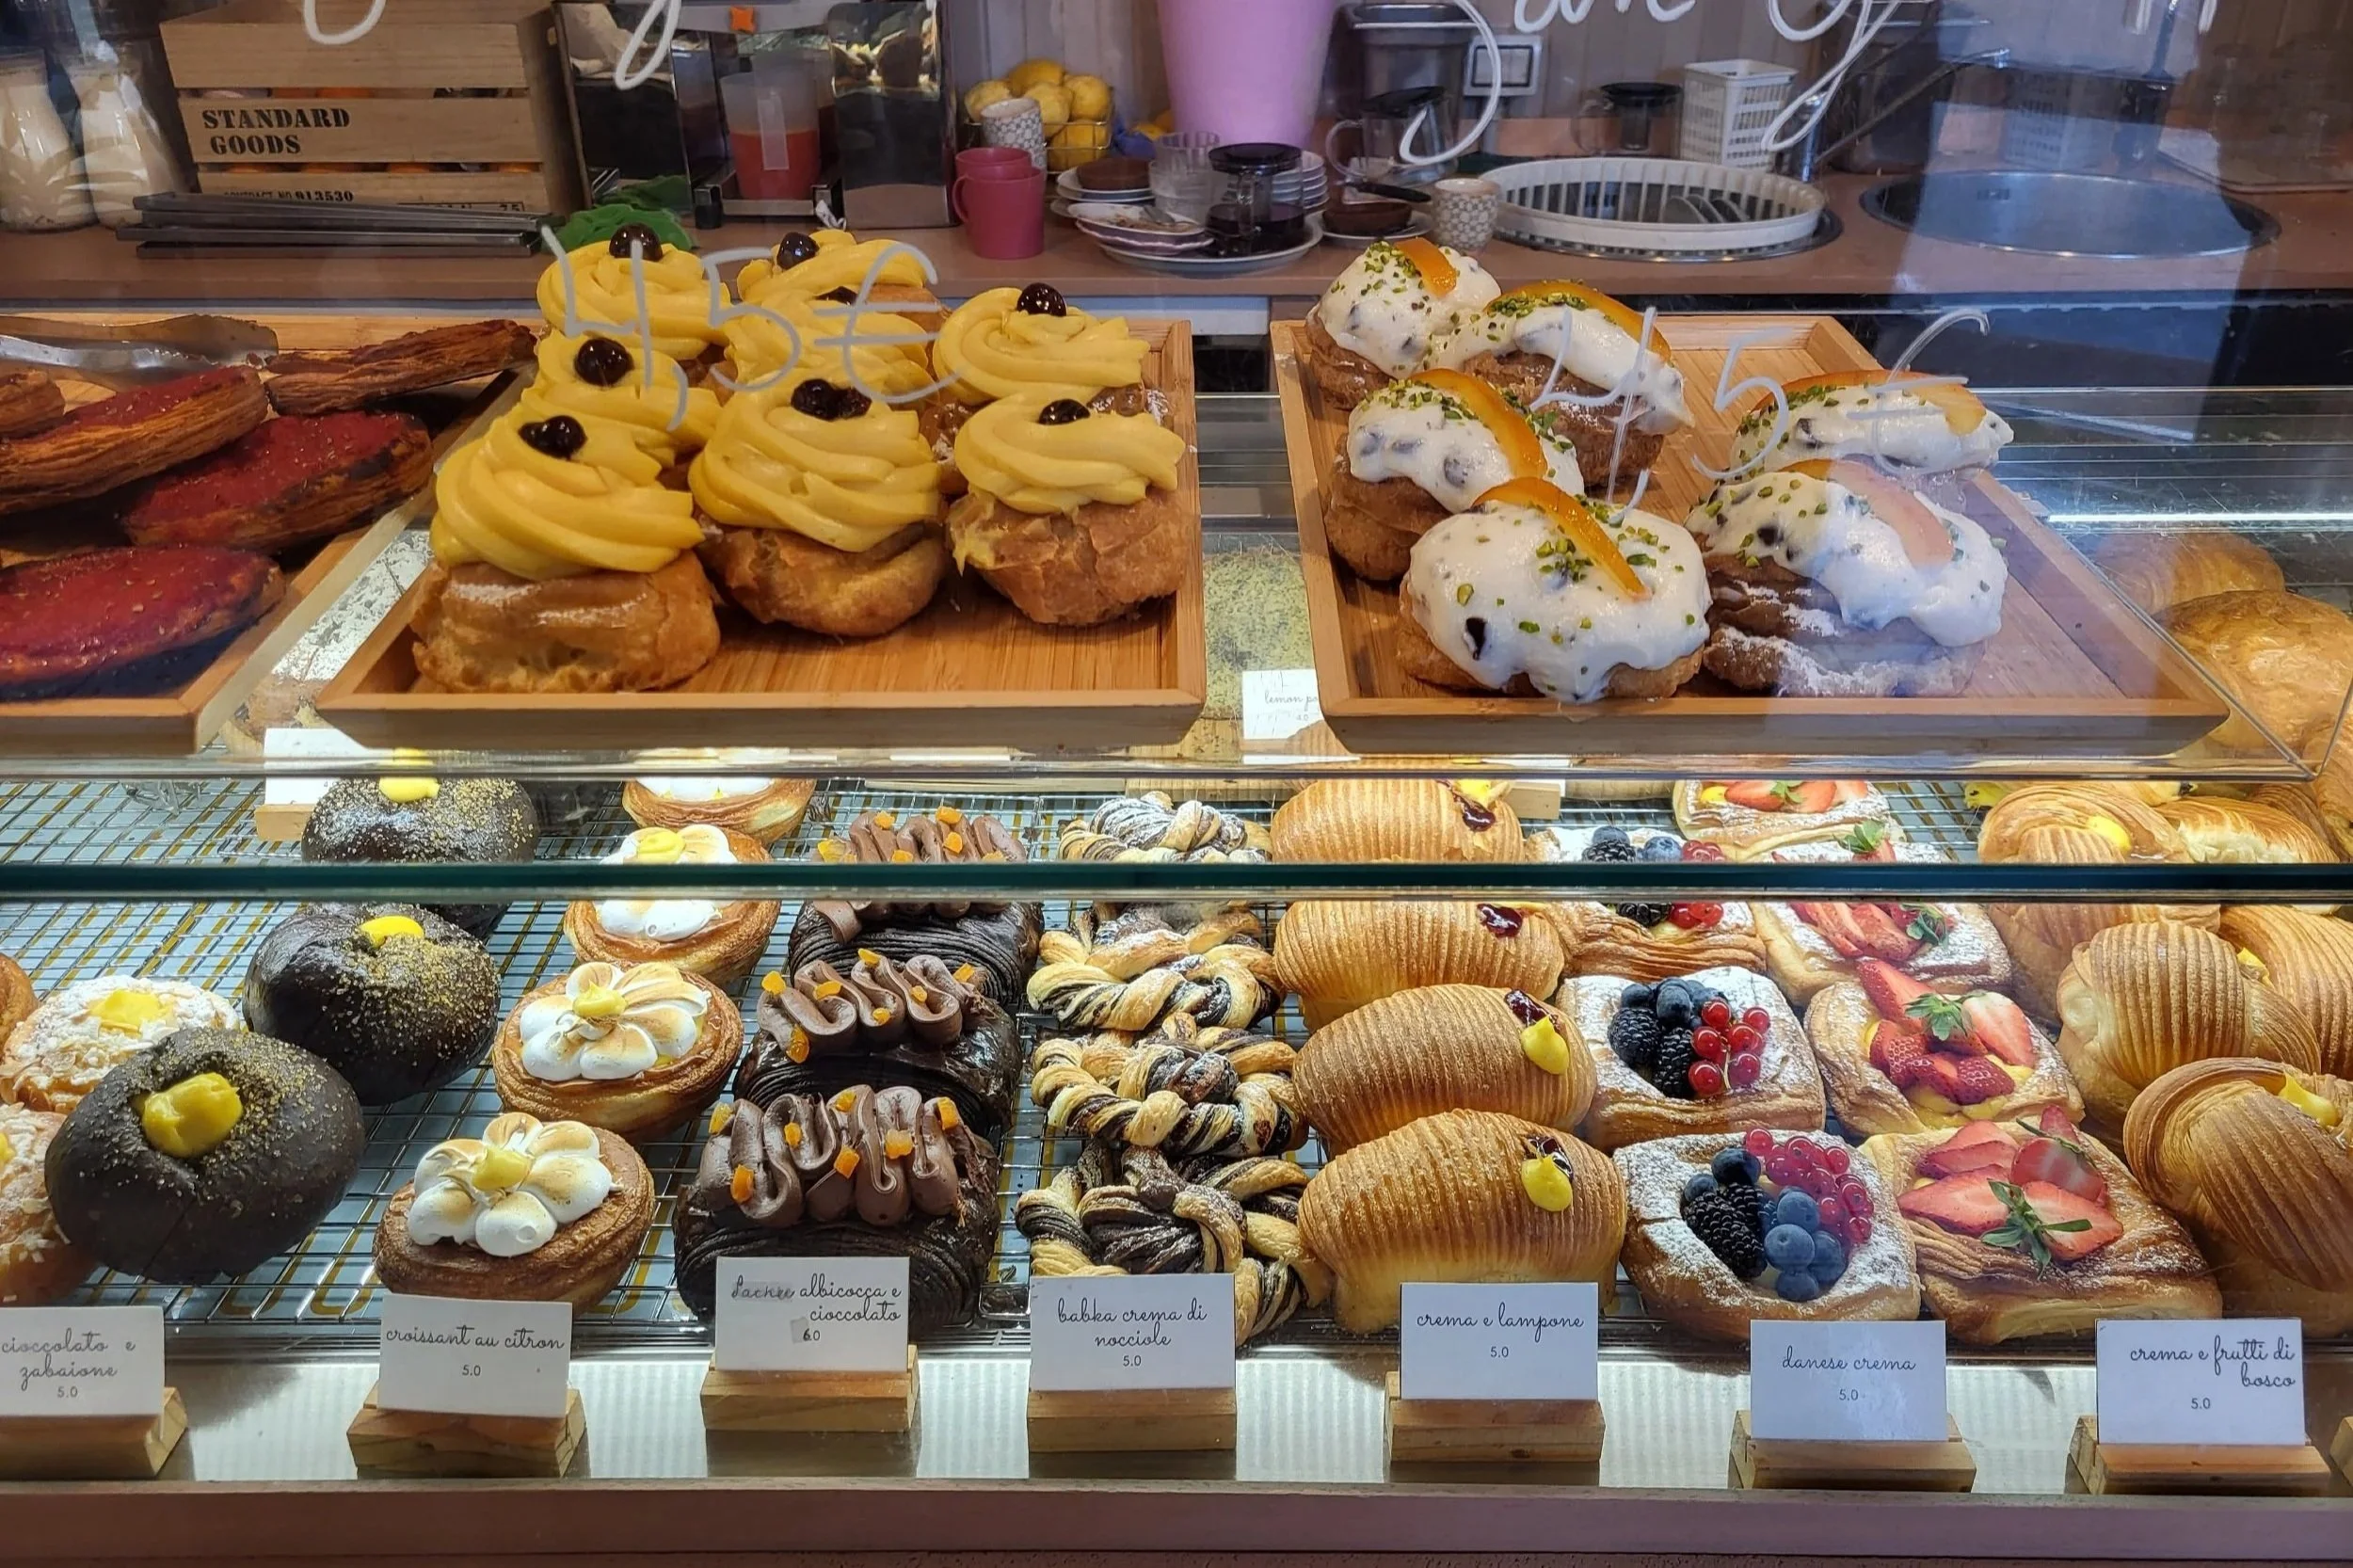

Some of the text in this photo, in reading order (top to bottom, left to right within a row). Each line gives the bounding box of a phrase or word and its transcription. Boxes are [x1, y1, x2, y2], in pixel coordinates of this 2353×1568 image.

[202, 108, 350, 129] STANDARD
[210, 135, 301, 154] GOODS
[799, 1272, 887, 1299] albicocca
[892, 1287, 902, 1298] e
[809, 1297, 902, 1322] cioccolato
[1058, 1297, 1208, 1323] babka crema di
[1095, 1321, 1172, 1348] nocciole
[1417, 1302, 1584, 1343] crema e lampone
[1, 1328, 136, 1353] cioccolato e
[386, 1324, 565, 1350] croissant au citron
[1123, 1355, 1142, 1368] 5.0
[1490, 1346, 1510, 1359] 5.0
[1782, 1345, 1916, 1370] danese crema
[2130, 1335, 2296, 1376] crema e frutti di
[19, 1353, 117, 1392] zabaione
[461, 1365, 481, 1376] 5.0
[2240, 1361, 2296, 1387] bosco
[56, 1386, 78, 1399] 5.0
[1839, 1388, 1859, 1401] 5.0
[2191, 1397, 2211, 1410] 5.0
